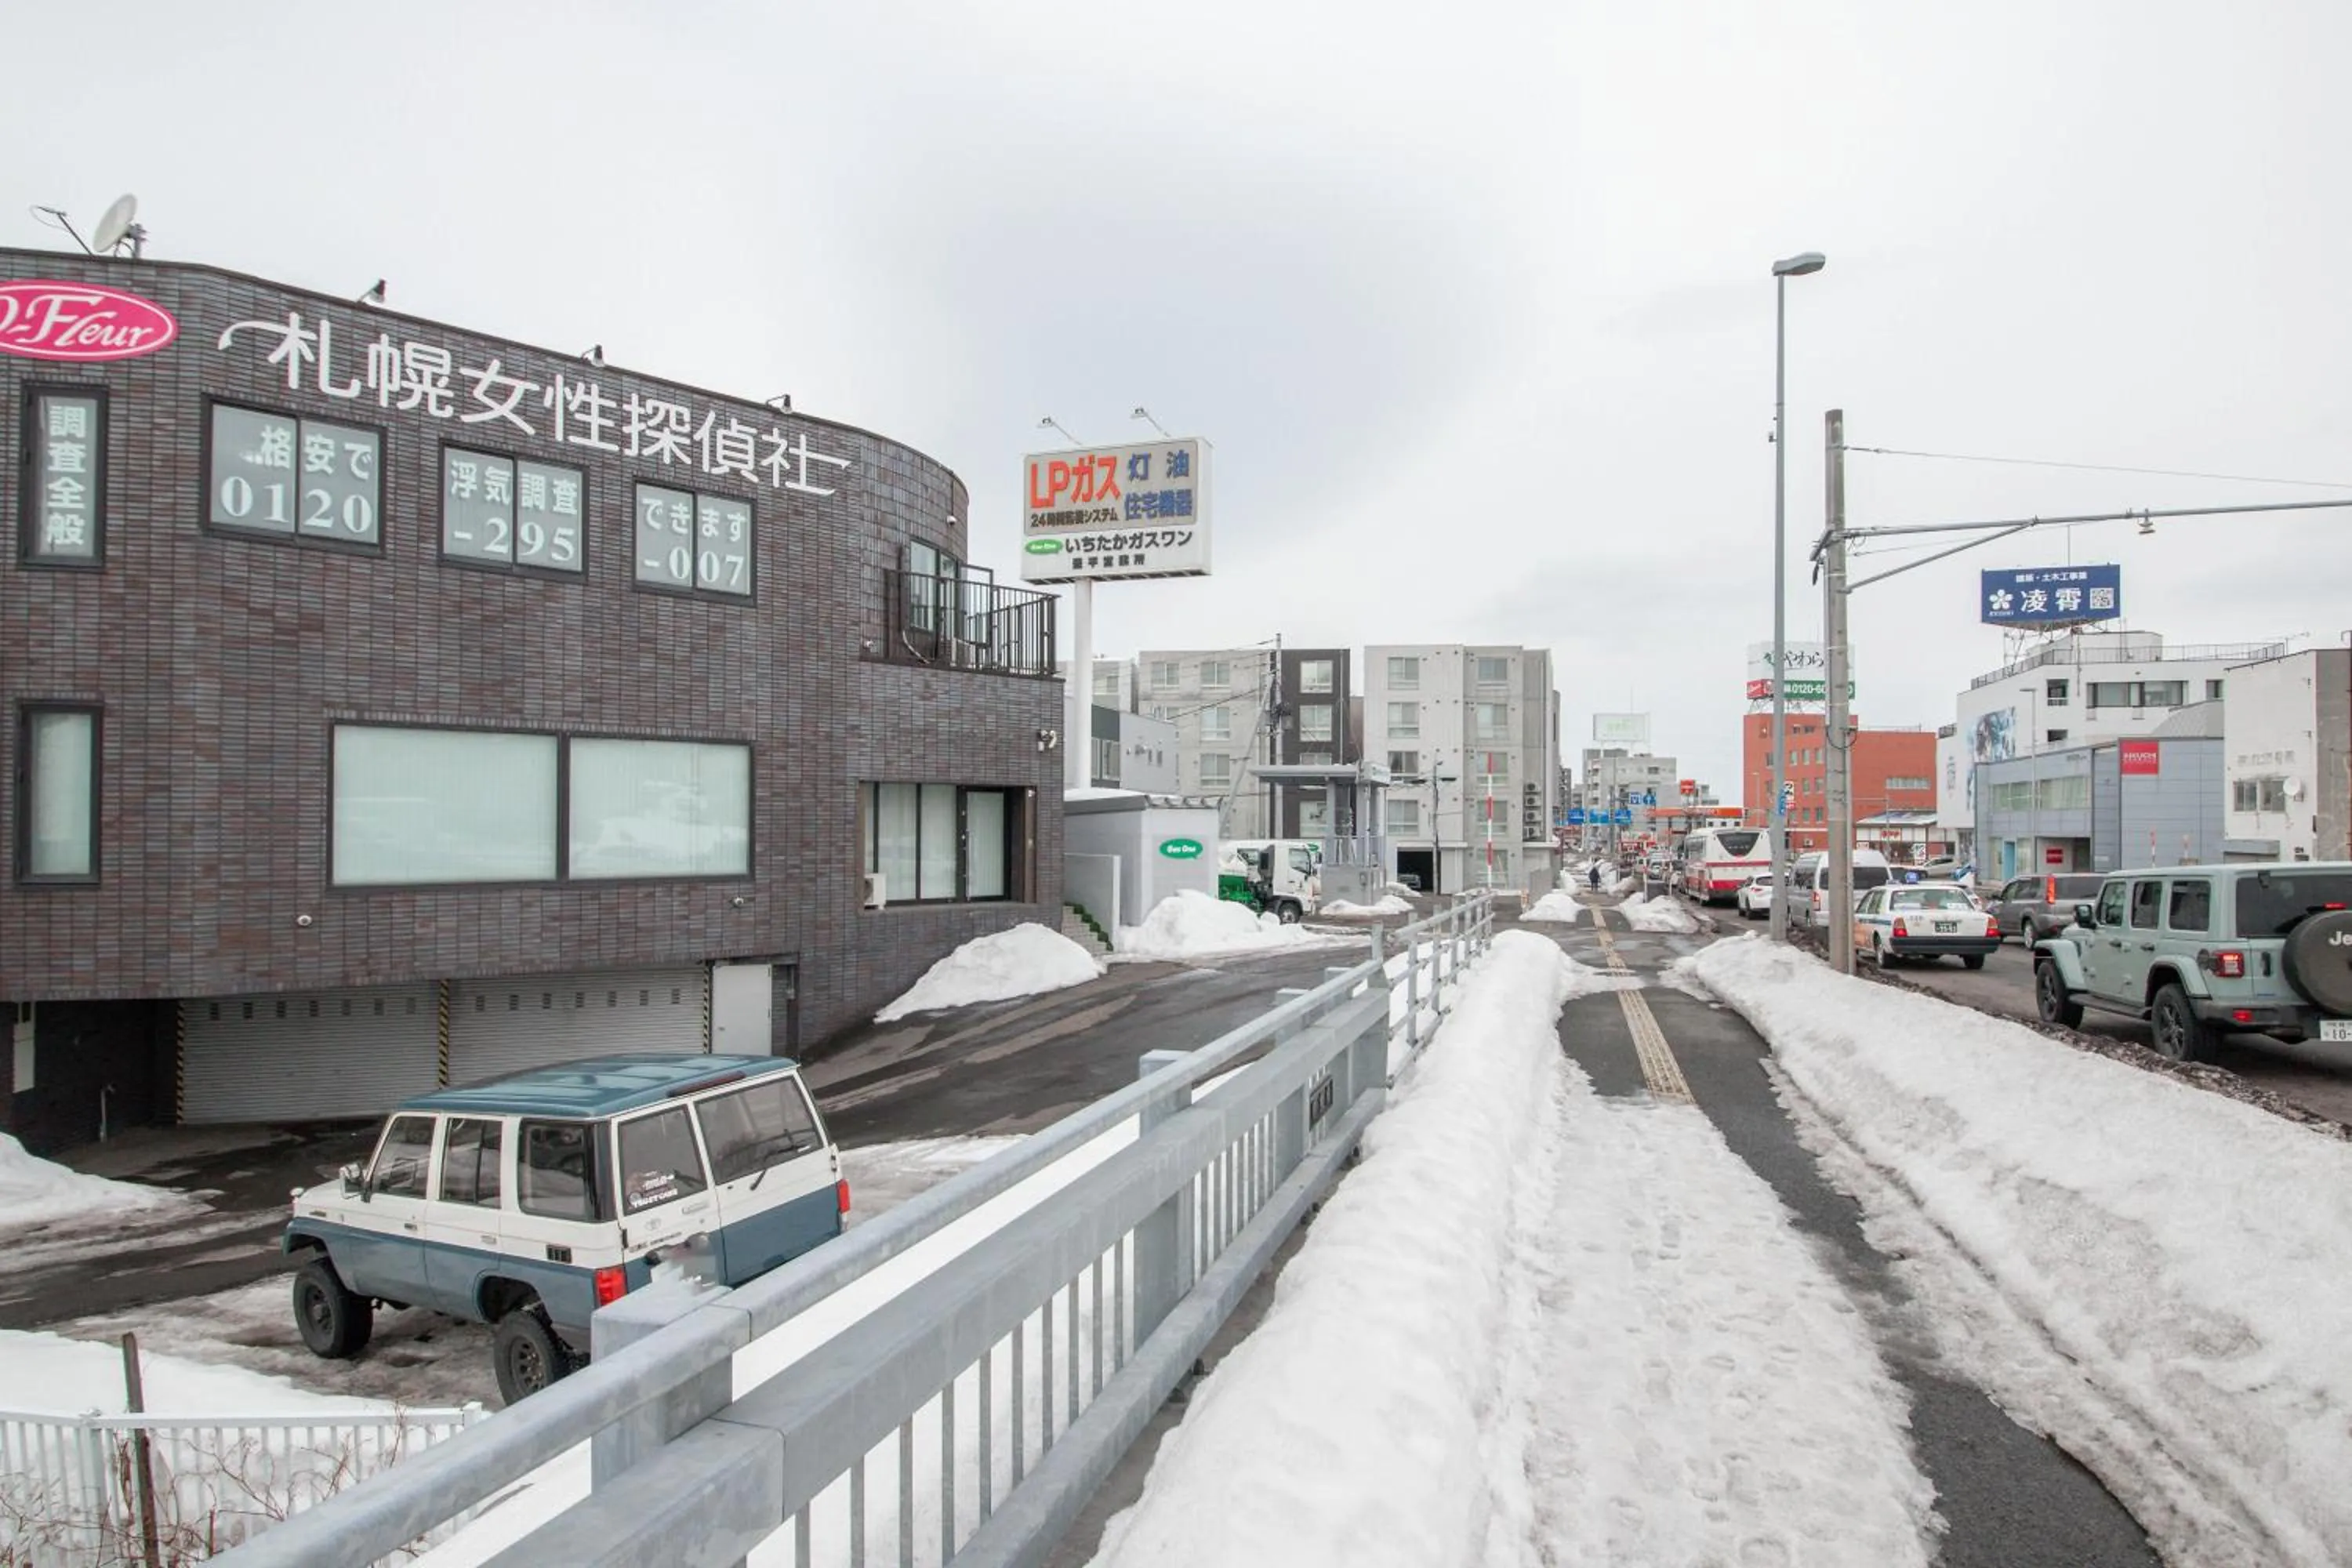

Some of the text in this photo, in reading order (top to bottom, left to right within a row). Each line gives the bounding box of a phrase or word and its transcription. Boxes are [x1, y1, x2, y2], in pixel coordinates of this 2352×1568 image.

[219, 312, 851, 495] 札幌女性探偵社
[45, 405, 87, 547] 調査全般
[220, 476, 372, 533] 0120
[260, 424, 746, 543] 格安で 浮気調査 できます
[1029, 454, 1121, 508] LPガス
[1065, 531, 1192, 553] いちたかガスワン
